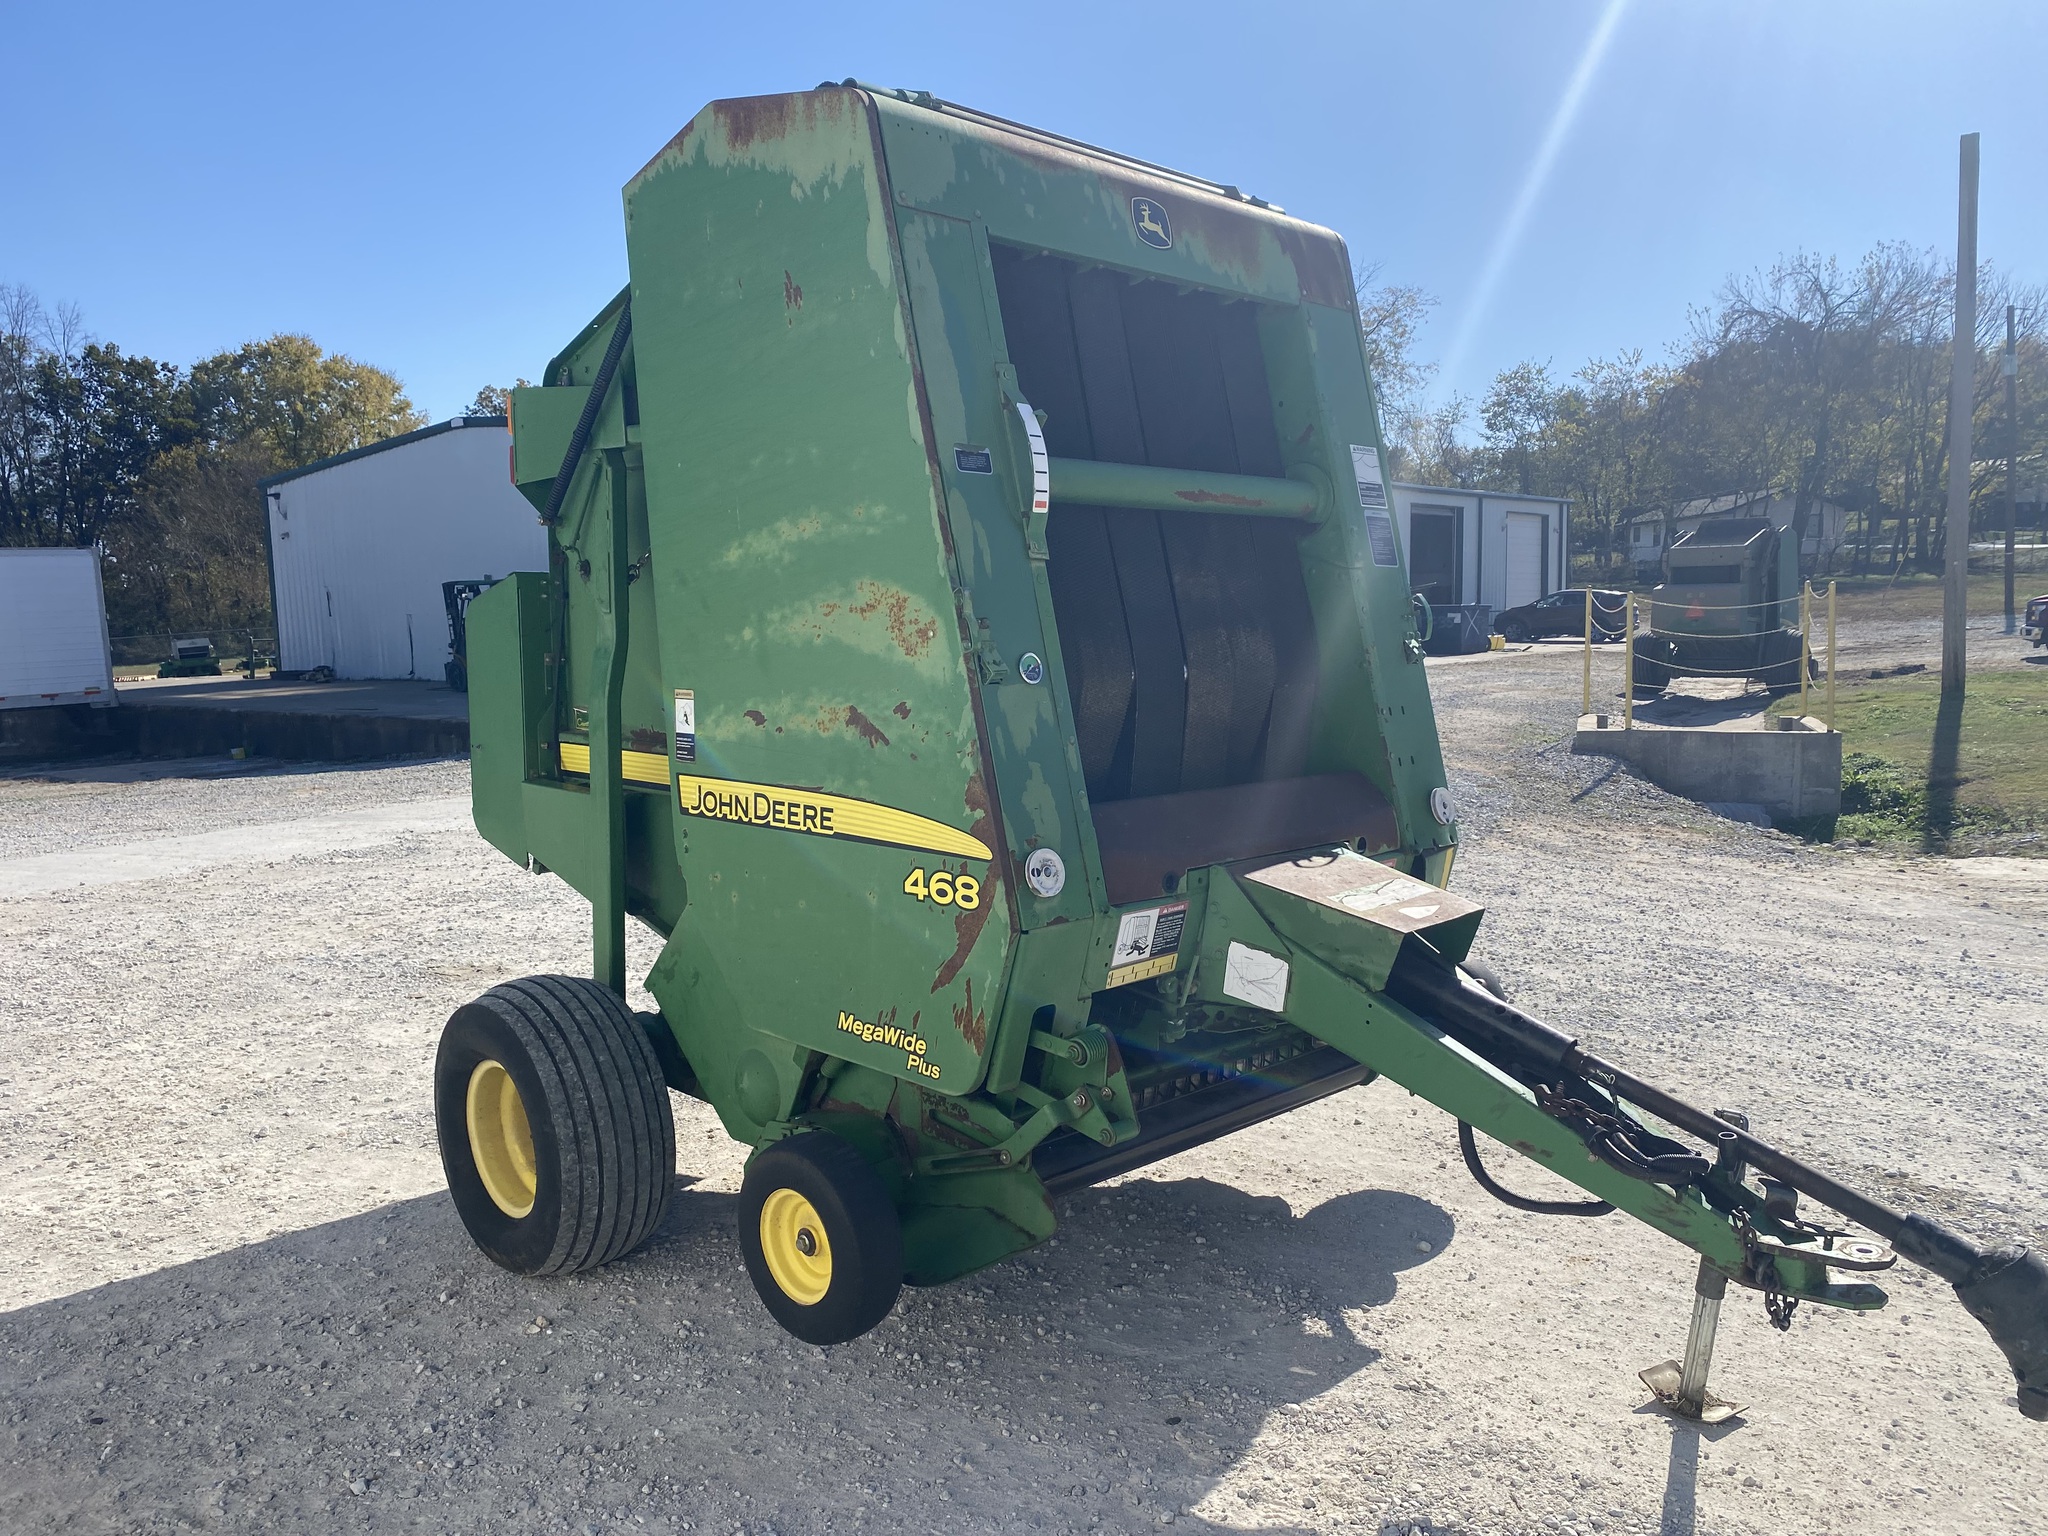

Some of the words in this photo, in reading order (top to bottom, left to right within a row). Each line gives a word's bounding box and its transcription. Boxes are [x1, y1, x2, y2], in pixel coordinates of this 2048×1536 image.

[690, 784, 749, 820] JOHN
[753, 792, 834, 832] DEERE
[903, 868, 980, 910] 468
[837, 1011, 927, 1055] MegaWide
[906, 1054, 941, 1079] Plus
